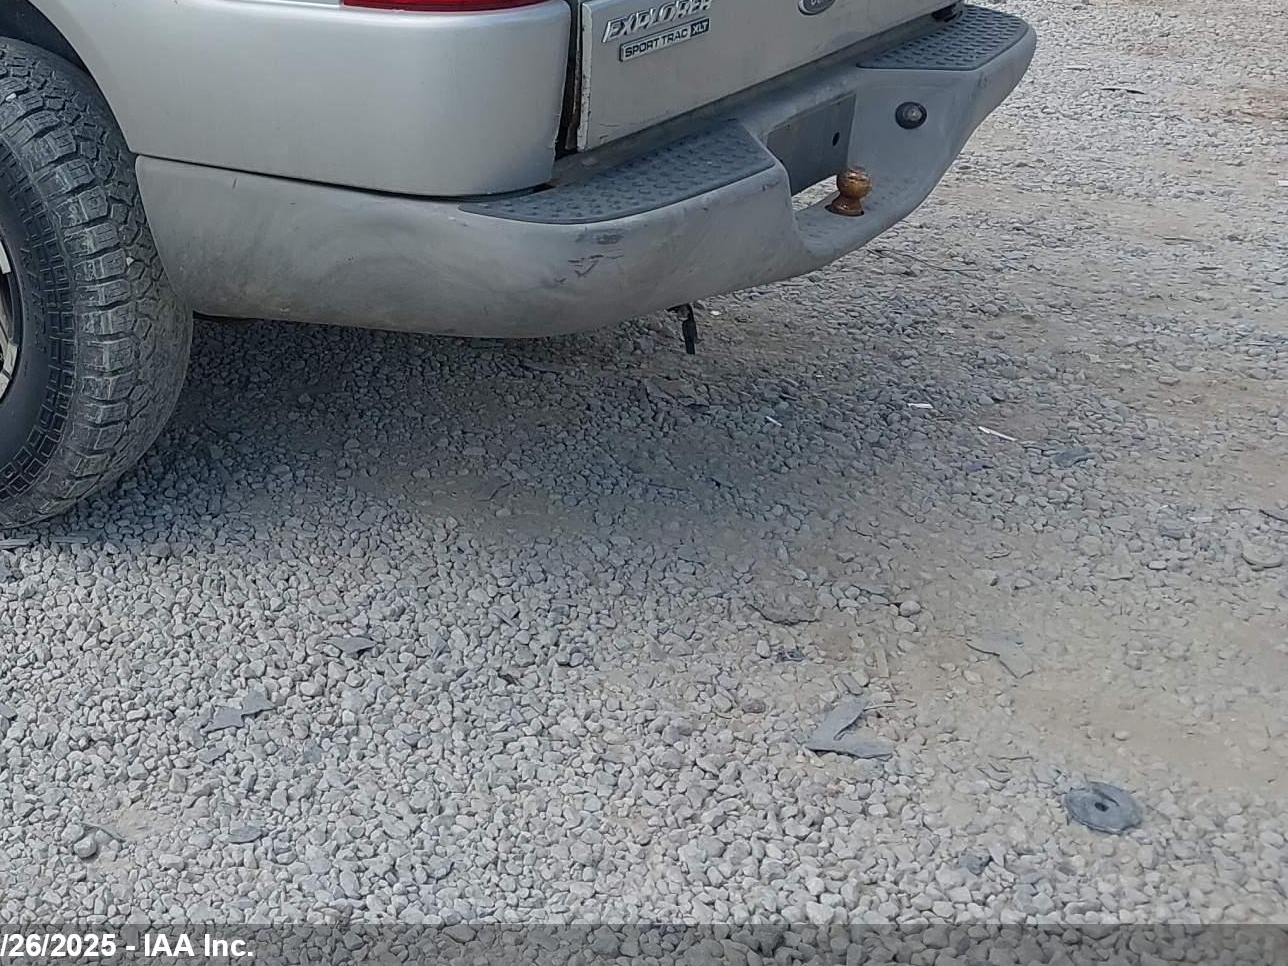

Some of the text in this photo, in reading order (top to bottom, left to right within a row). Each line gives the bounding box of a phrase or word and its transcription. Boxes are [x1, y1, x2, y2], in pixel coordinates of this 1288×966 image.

[624, 20, 709, 58] SPORT TRAC XLT
